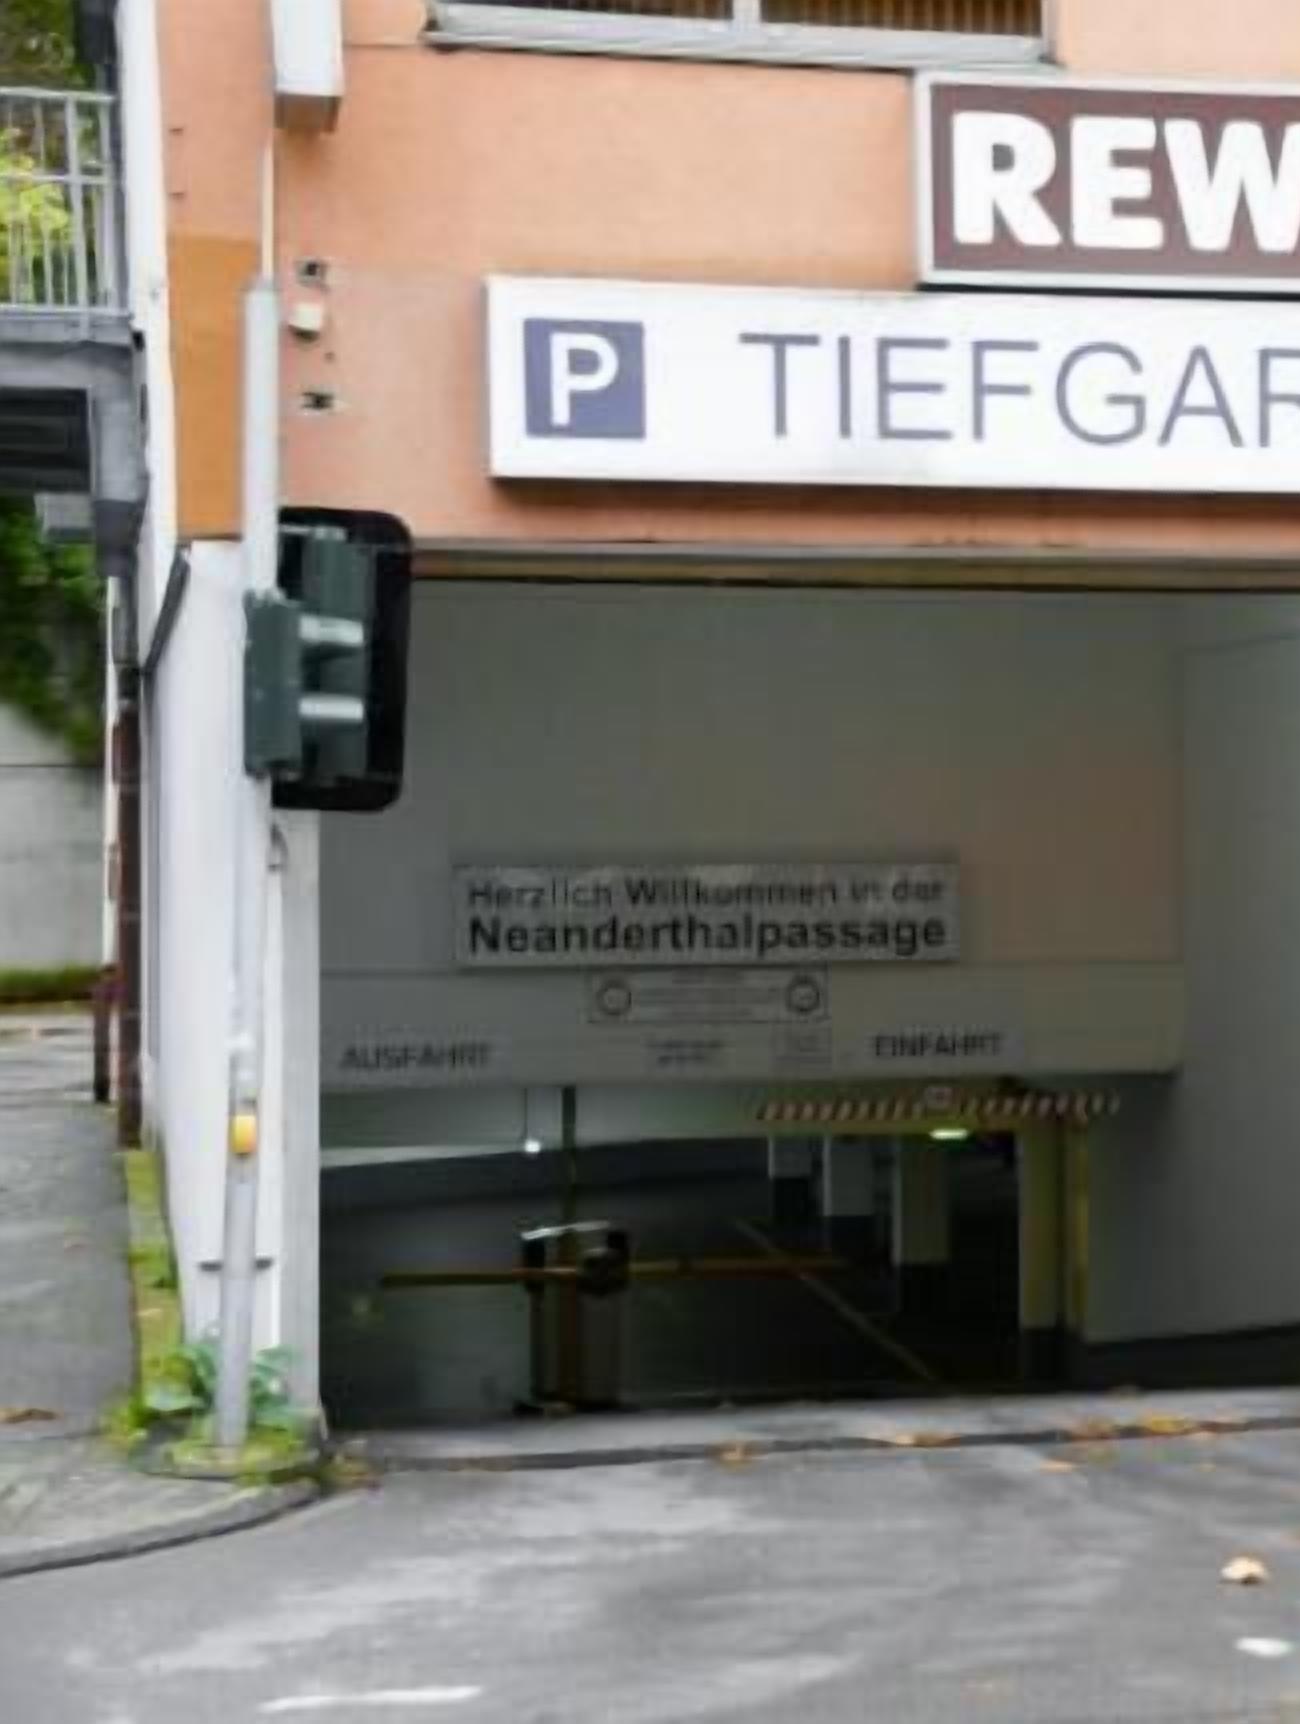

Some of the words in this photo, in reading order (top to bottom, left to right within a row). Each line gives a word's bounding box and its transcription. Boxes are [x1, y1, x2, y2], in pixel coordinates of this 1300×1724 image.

[549, 331, 619, 427] P
[468, 877, 613, 908] Herzlich
[624, 876, 838, 907] Willkommen
[850, 876, 882, 902] in
[891, 876, 945, 903] der
[468, 912, 948, 958] Neanderthalpassage
[338, 1039, 492, 1070] AUSFAHRT
[873, 1031, 1003, 1058] EINFAHRT
